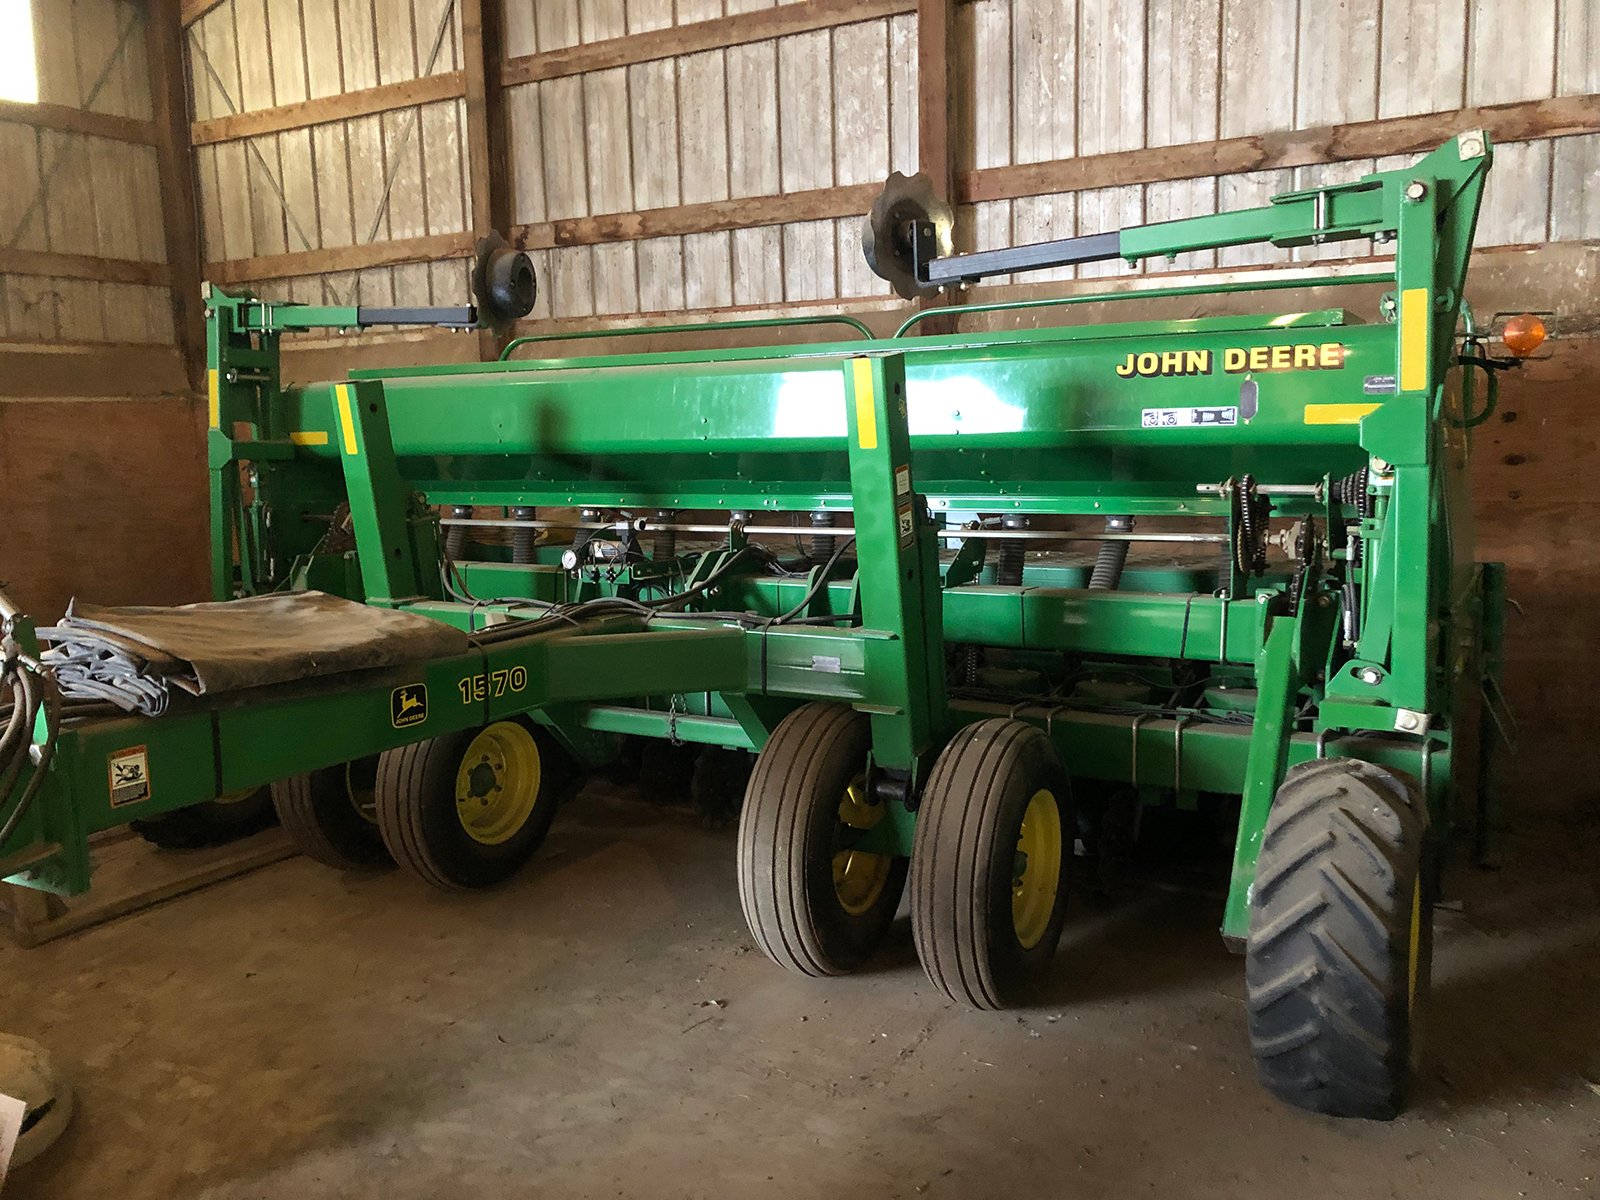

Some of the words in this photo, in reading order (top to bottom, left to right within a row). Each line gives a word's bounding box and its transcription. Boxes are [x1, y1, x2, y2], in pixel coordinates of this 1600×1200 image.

[1116, 350, 1211, 378] JOHN
[1224, 343, 1343, 373] DEERE
[458, 666, 527, 704] 1570
